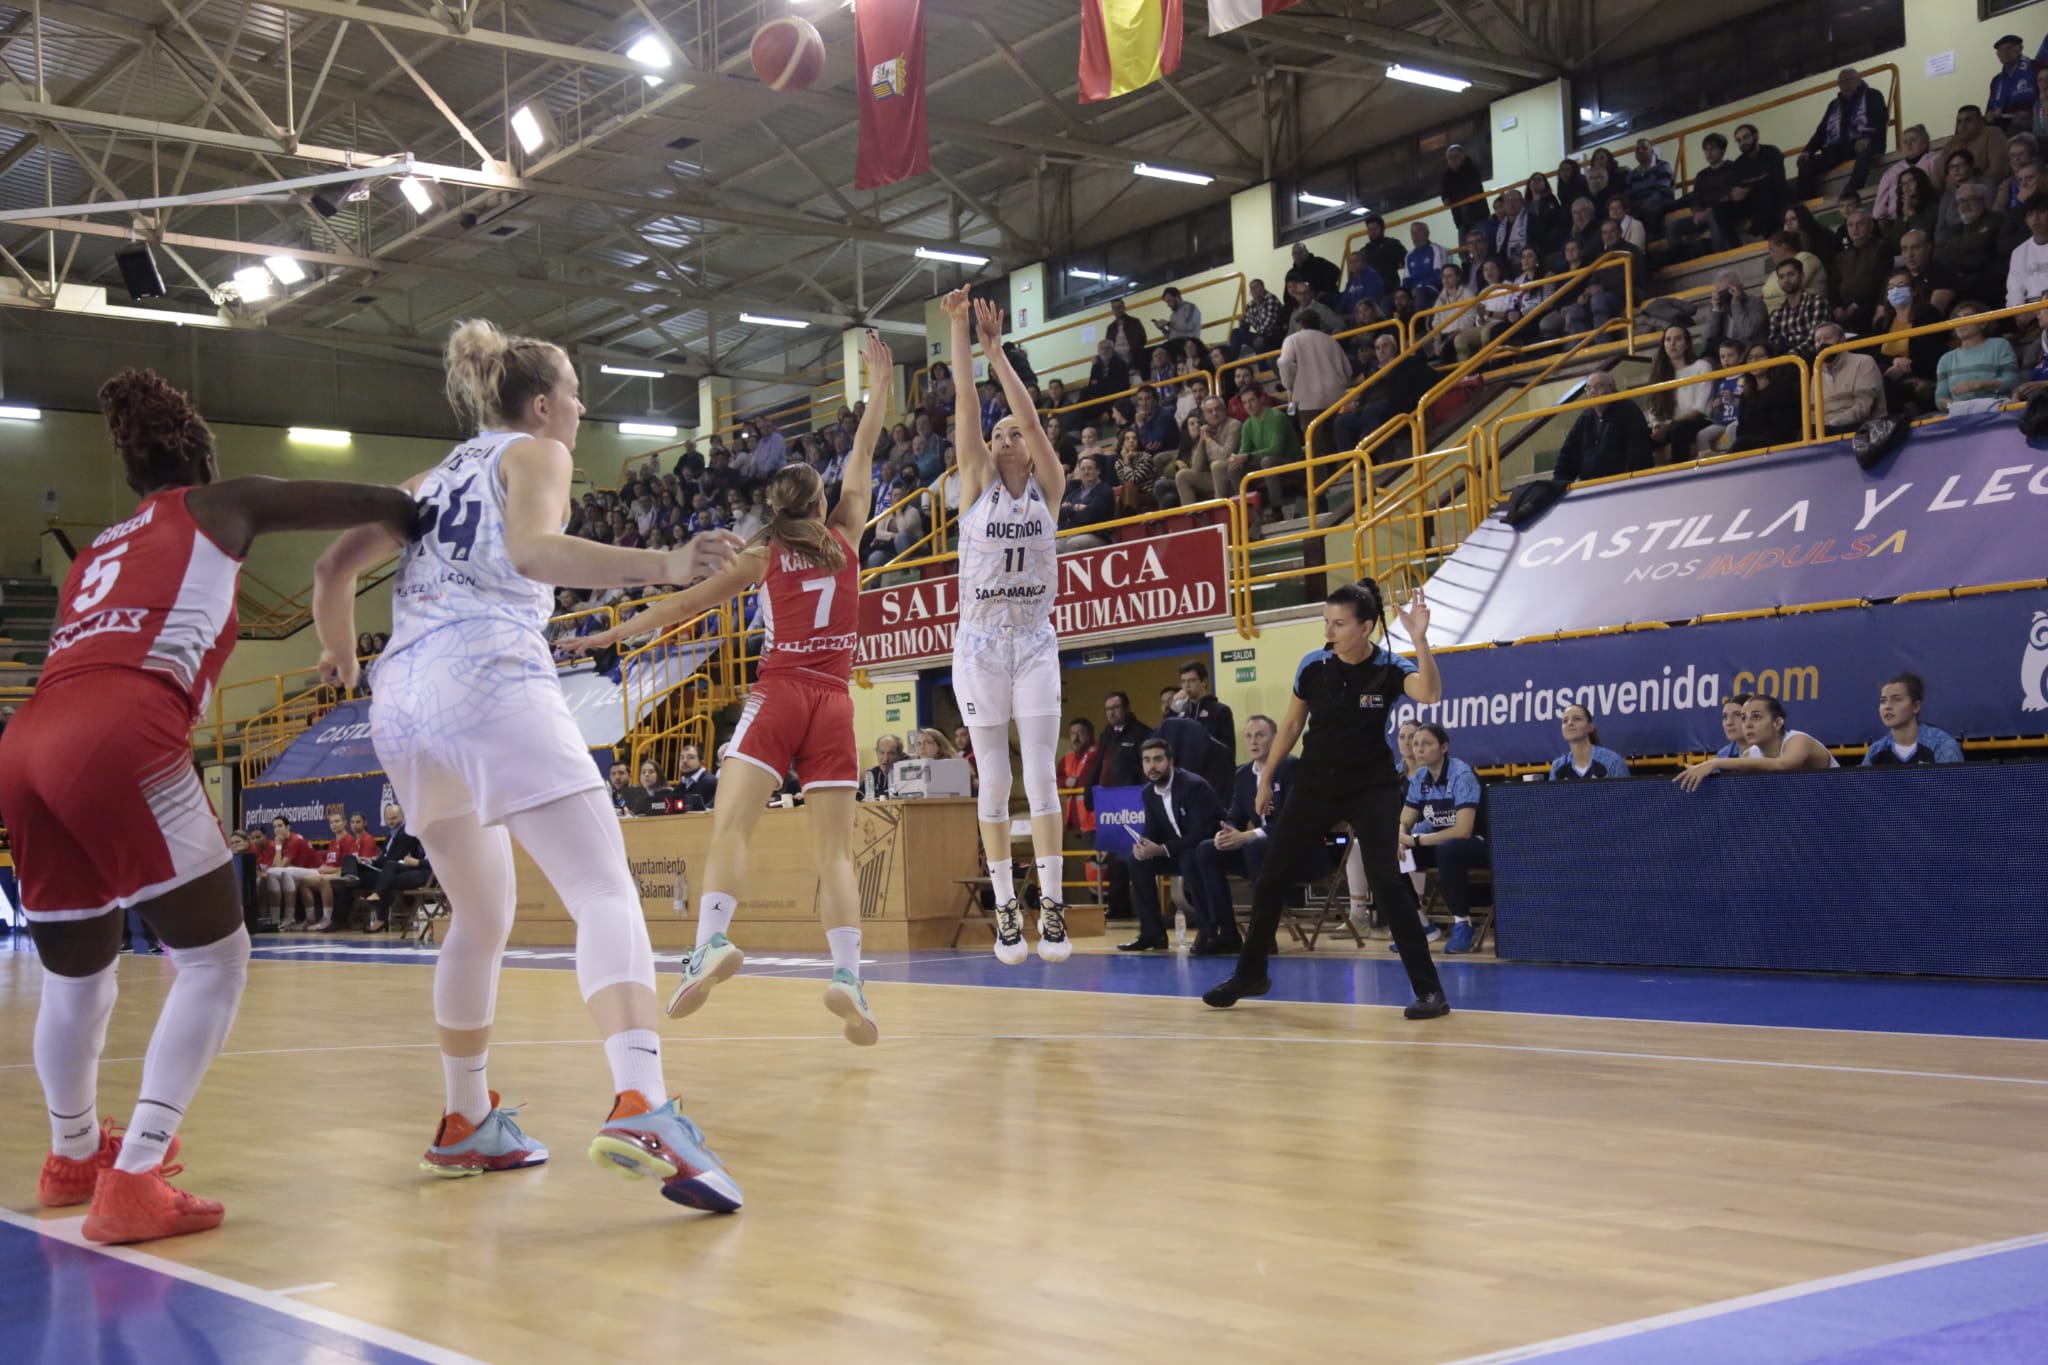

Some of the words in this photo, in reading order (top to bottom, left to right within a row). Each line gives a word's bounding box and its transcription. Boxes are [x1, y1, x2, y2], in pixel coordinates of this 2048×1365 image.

[91, 501, 157, 549] GREEN
[1517, 500, 1809, 568] CASTILLA
[1854, 483, 1913, 530] Y
[1926, 464, 2048, 513] LE
[72, 541, 129, 613] 5
[1004, 546, 1026, 573] 11
[801, 575, 837, 630] 7
[975, 585, 1047, 600] SALAMANCA
[854, 622, 958, 663] ATRIMONI
[1054, 581, 1216, 634] HUMANIDAD
[1099, 808, 1146, 826] molten
